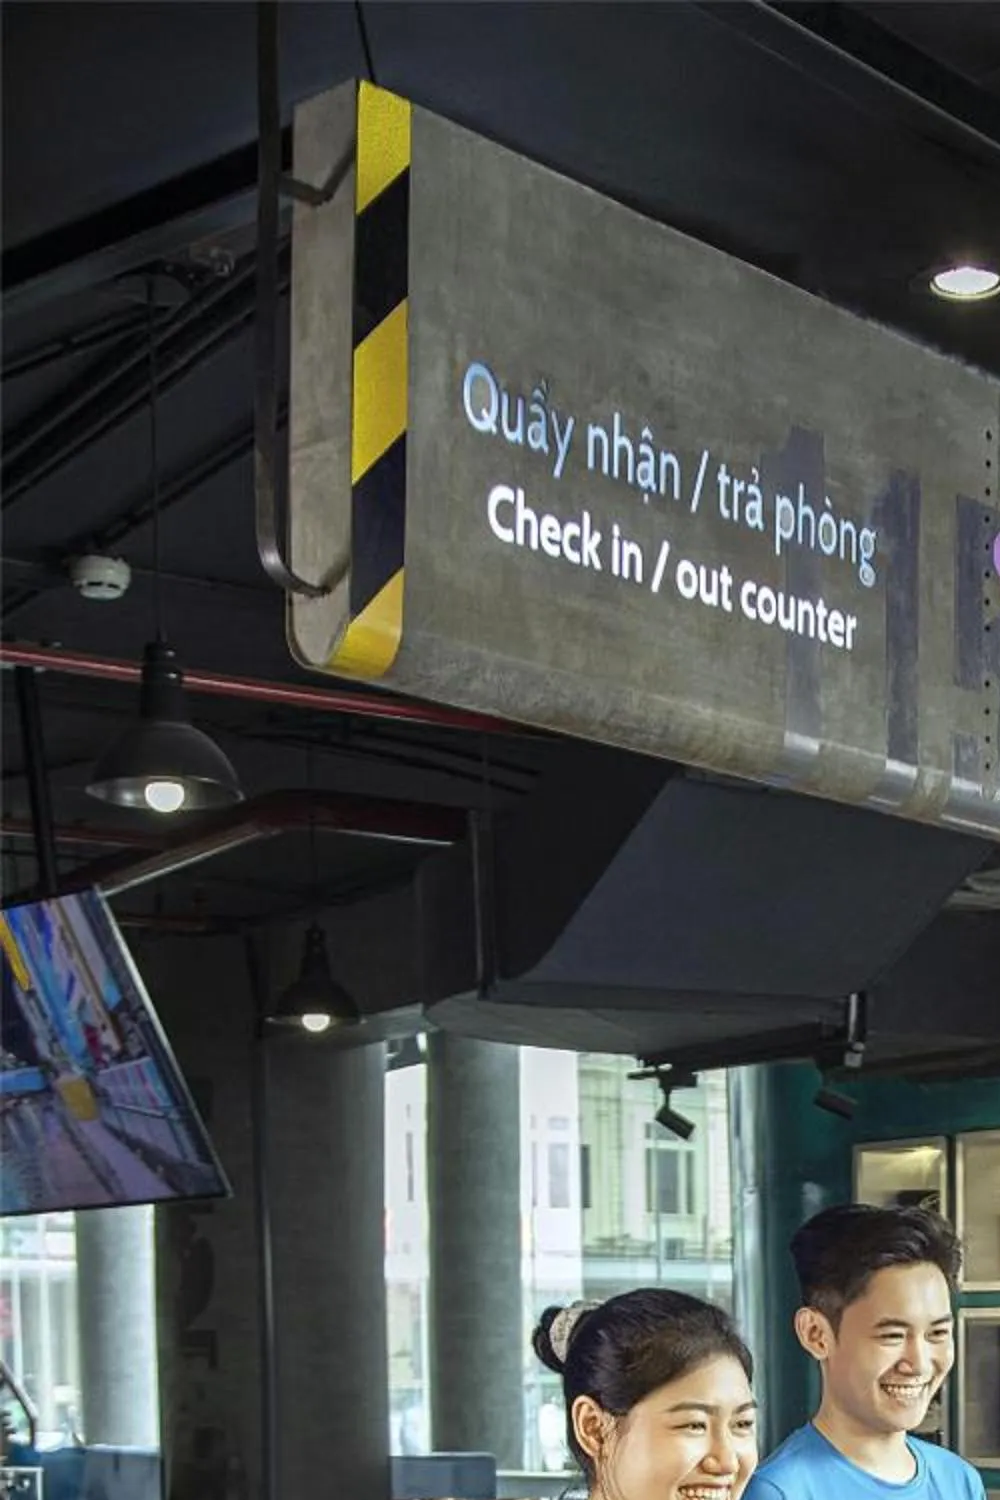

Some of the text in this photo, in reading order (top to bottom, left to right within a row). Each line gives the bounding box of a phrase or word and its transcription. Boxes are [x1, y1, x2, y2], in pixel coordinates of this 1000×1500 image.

[487, 484, 857, 650] Check in / out counter
[586, 411, 681, 504] nhận
[690, 450, 709, 513] /
[717, 463, 764, 532] trả
[775, 482, 877, 588] phòng
